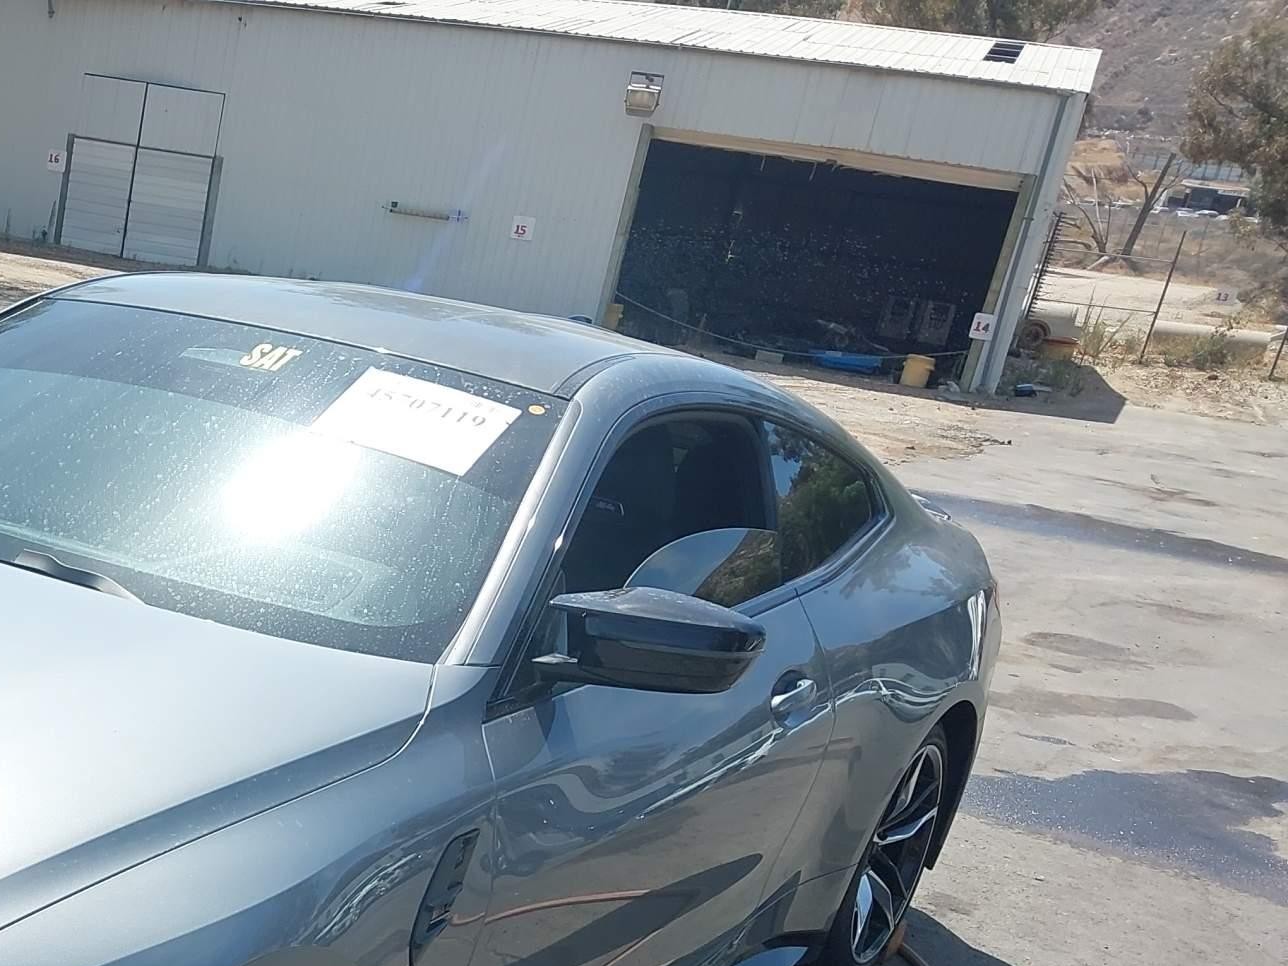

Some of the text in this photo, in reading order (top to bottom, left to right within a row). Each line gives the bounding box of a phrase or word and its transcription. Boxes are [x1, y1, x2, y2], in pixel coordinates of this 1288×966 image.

[48, 153, 60, 164] 16
[513, 224, 528, 236] 15
[1216, 292, 1230, 302] 13
[973, 321, 991, 334] 14
[239, 343, 304, 372] SAT
